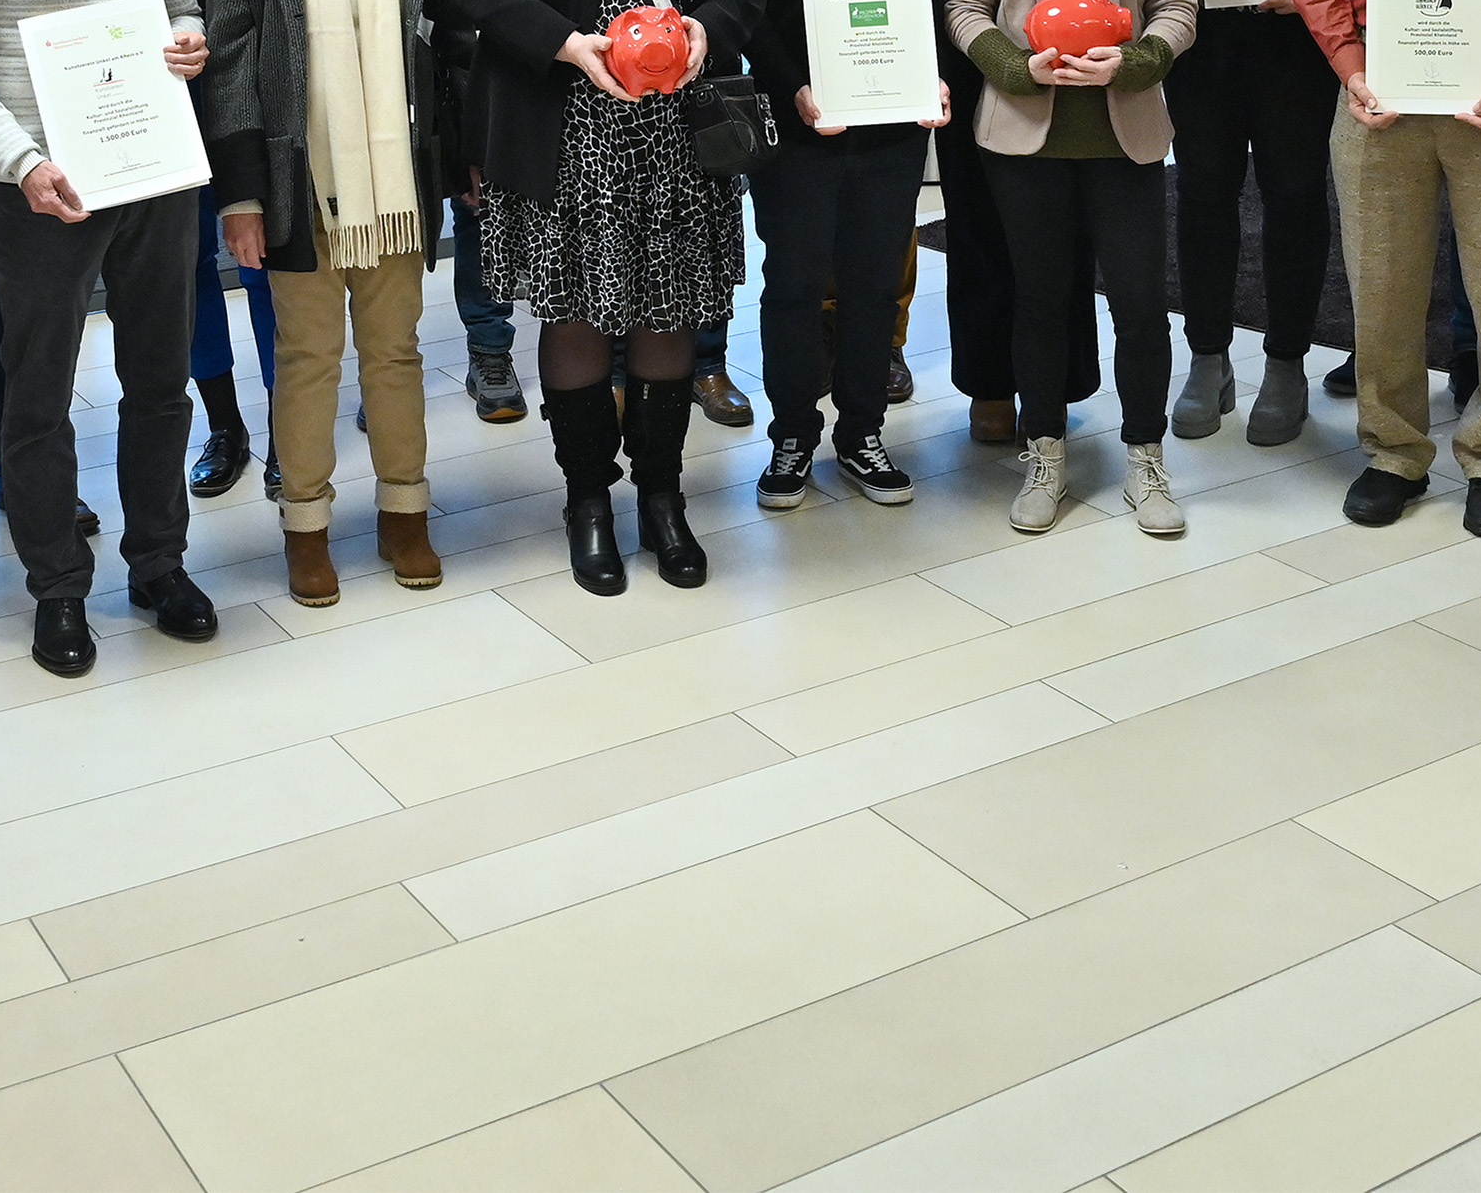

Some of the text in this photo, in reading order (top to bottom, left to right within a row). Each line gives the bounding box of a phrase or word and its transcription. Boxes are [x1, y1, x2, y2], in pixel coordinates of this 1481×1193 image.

[853, 58, 879, 66] 3.000,00
[119, 109, 143, 119] Rheinland
[100, 128, 147, 143] 1.500,00 Euro
